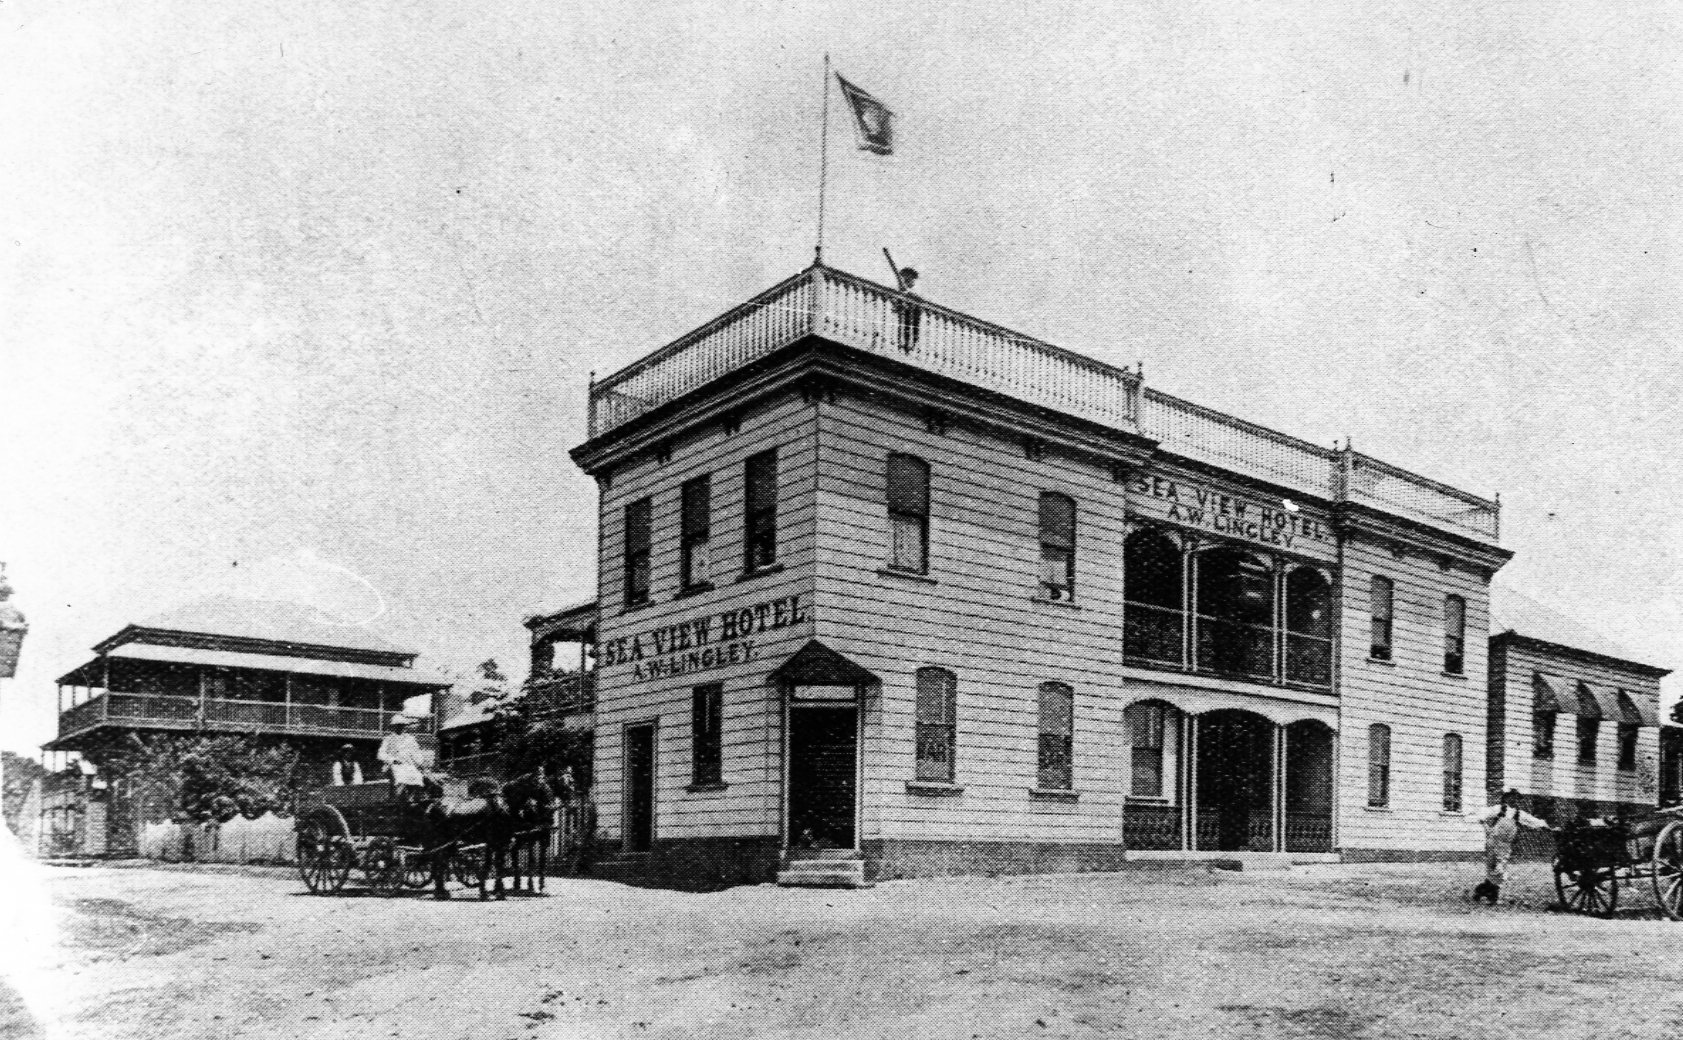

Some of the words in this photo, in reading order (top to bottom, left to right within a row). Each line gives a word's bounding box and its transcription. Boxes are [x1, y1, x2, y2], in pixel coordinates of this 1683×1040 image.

[1135, 476, 1179, 502] SEA
[1195, 488, 1247, 518] VIEW
[605, 636, 644, 666] SEA
[653, 616, 711, 655] VIEW
